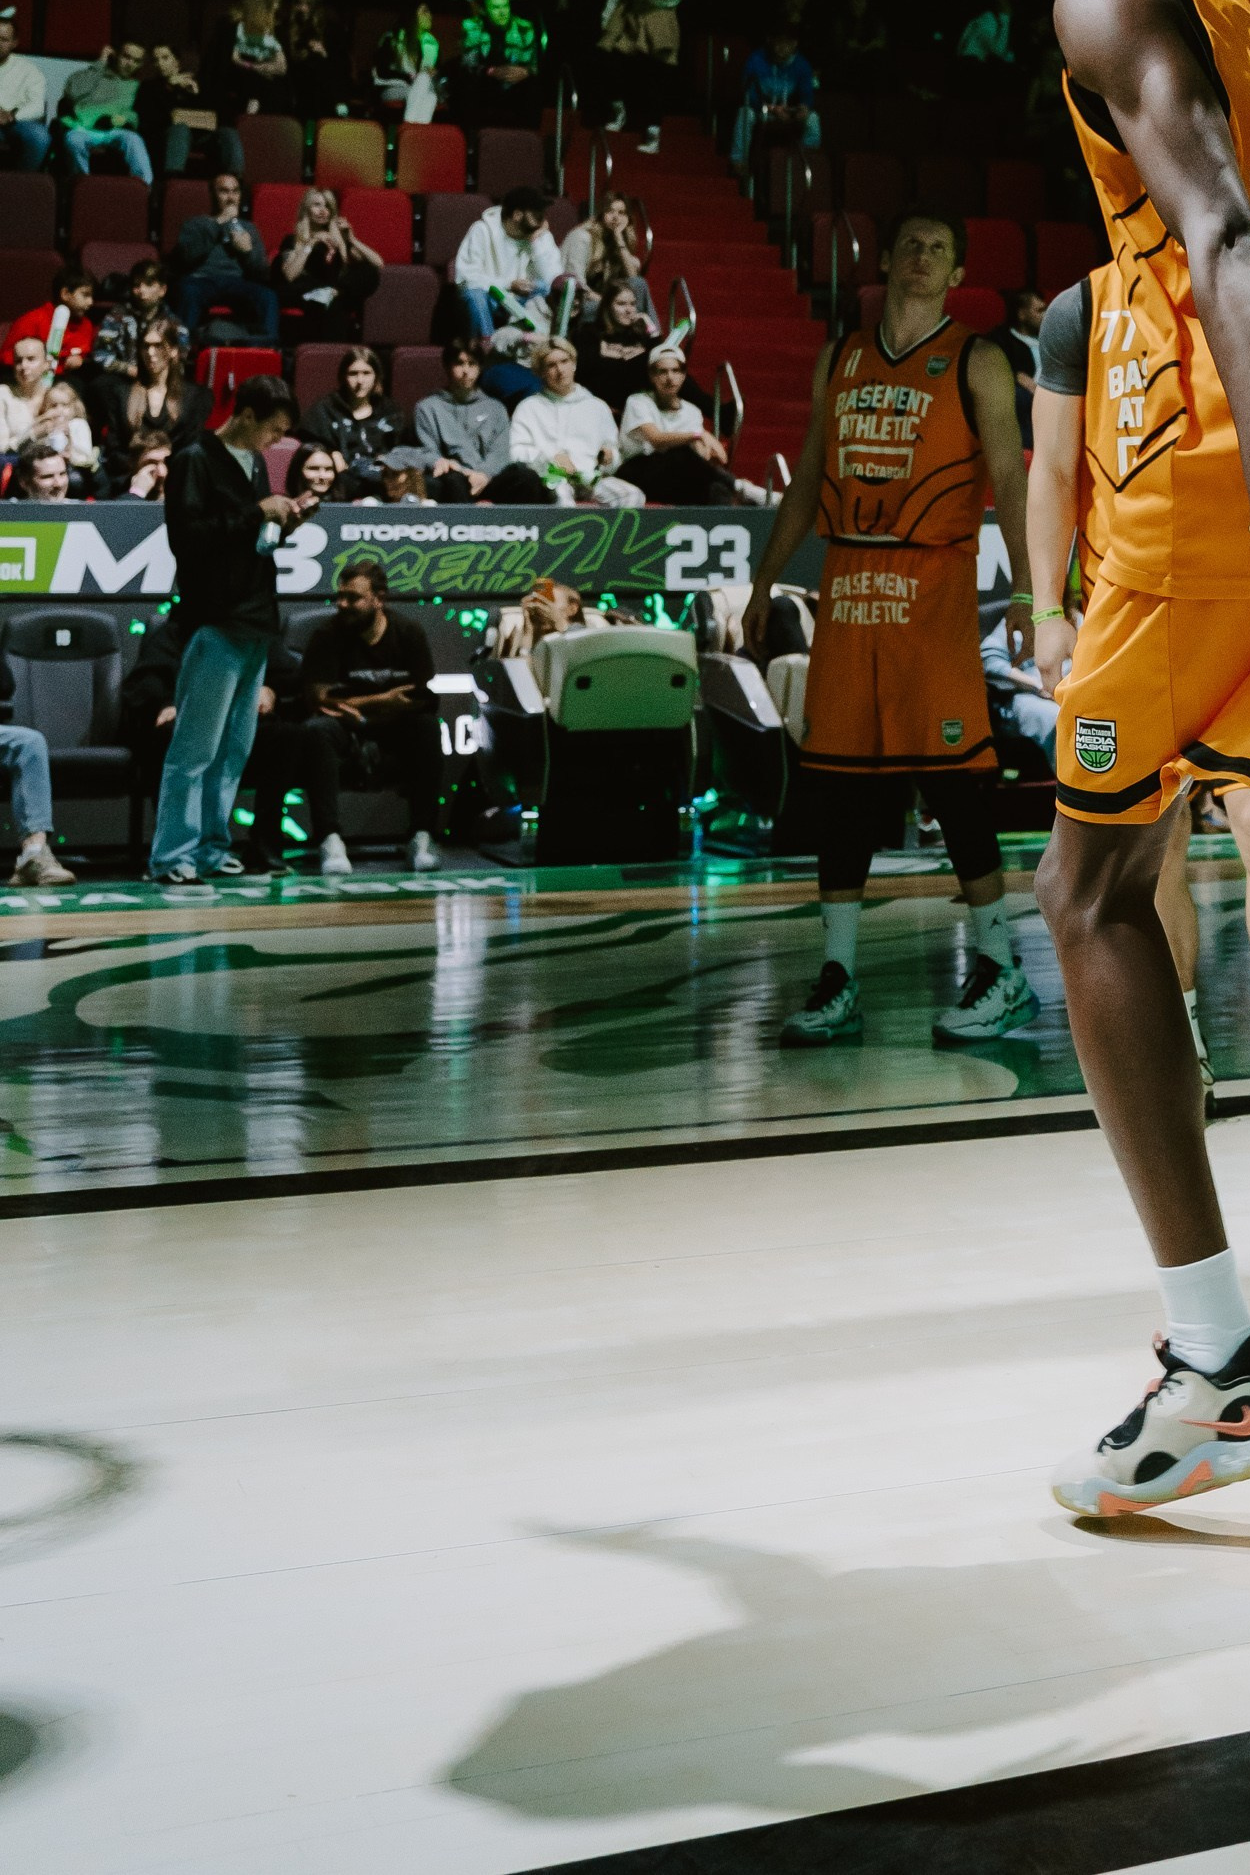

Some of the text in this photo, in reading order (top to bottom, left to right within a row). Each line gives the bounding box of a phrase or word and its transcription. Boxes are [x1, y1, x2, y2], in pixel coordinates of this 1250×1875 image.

[1100, 310, 1137, 354] 77
[834, 384, 934, 418] BASEMENT
[838, 413, 920, 441] ATHLETIC
[340, 522, 539, 541] ВТОРОЙ СЕЗОН
[831, 571, 920, 601] BASEMENT
[832, 600, 910, 625] ATHLETIC
[1076, 734, 1116, 746] MEDIA
